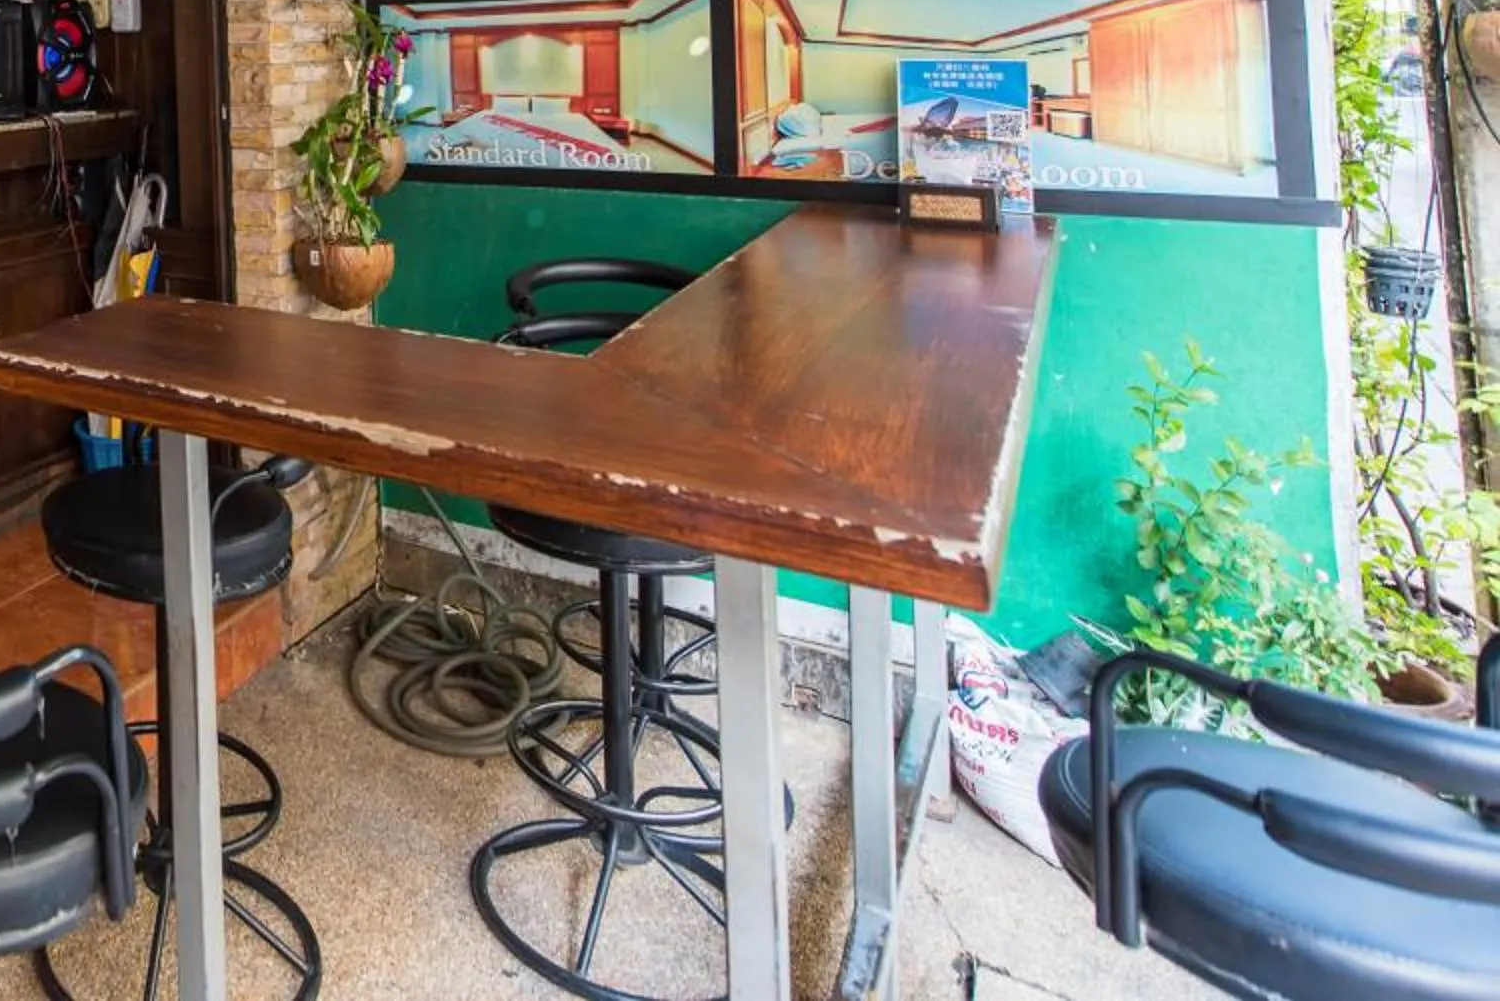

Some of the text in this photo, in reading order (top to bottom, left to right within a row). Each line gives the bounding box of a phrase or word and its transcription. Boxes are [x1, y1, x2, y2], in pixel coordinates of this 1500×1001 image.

[424, 135, 653, 172] Standard Room
[1031, 162, 1147, 190] oom
